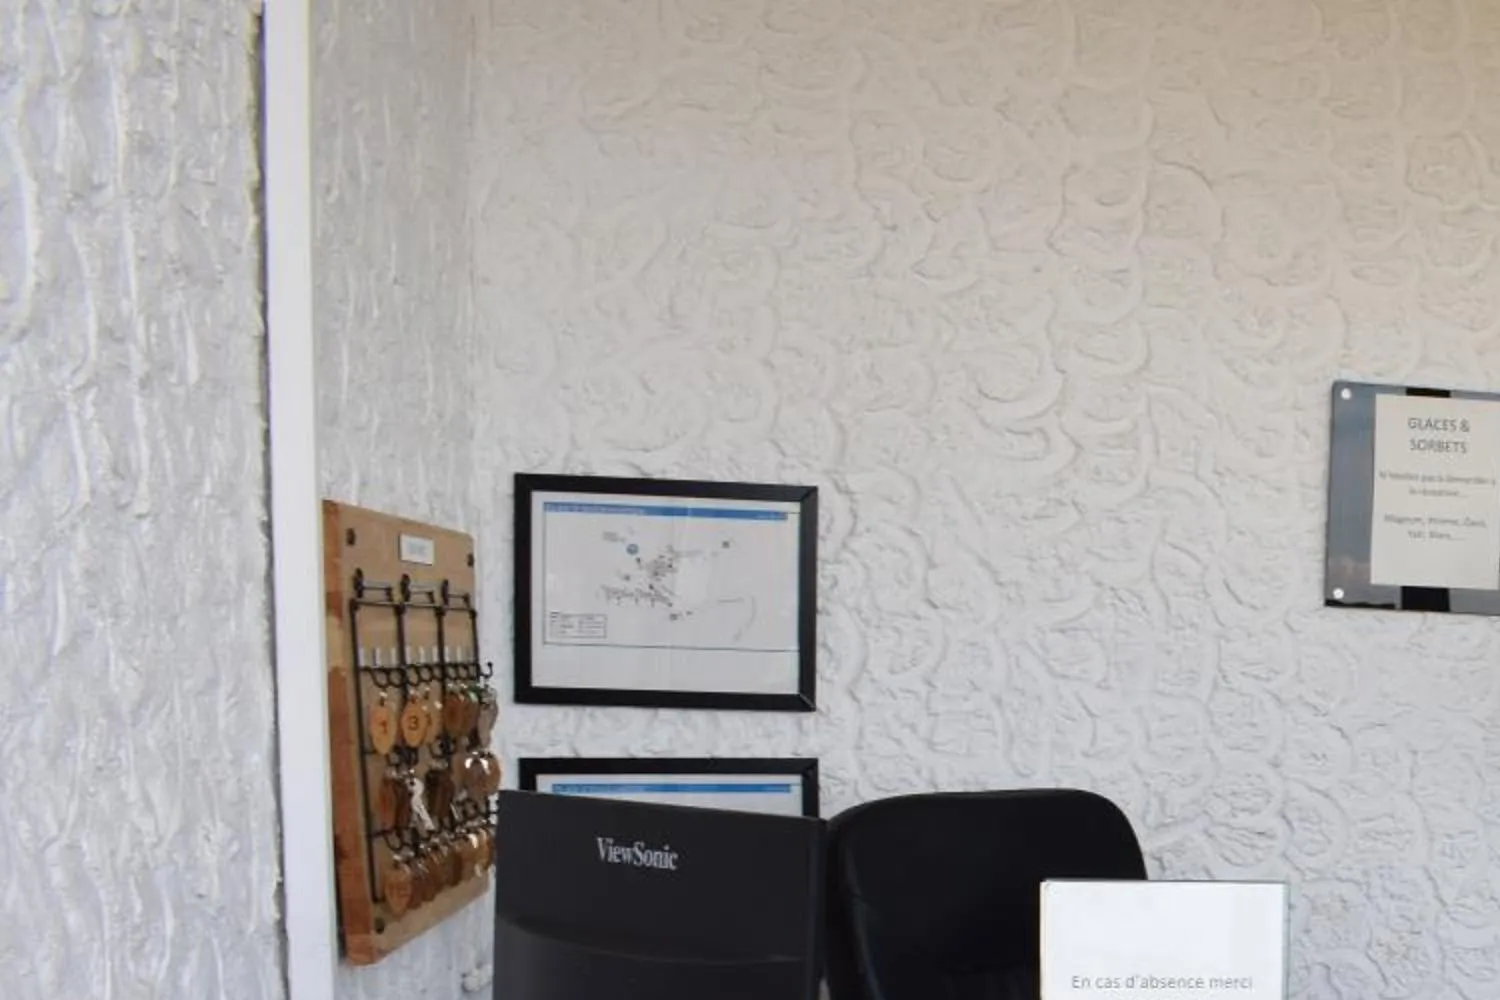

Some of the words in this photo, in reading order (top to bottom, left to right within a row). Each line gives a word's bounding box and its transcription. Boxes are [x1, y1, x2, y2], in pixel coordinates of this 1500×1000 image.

[1407, 417, 1457, 432] GLACES
[1459, 418, 1471, 433] &
[1408, 439, 1468, 454] SORBETS
[408, 715, 418, 731] 3
[597, 837, 679, 871] ViewSonic
[1071, 975, 1091, 989] En
[1095, 978, 1120, 990] cas
[1125, 975, 1205, 990] d'absence
[1209, 975, 1253, 990] merci
